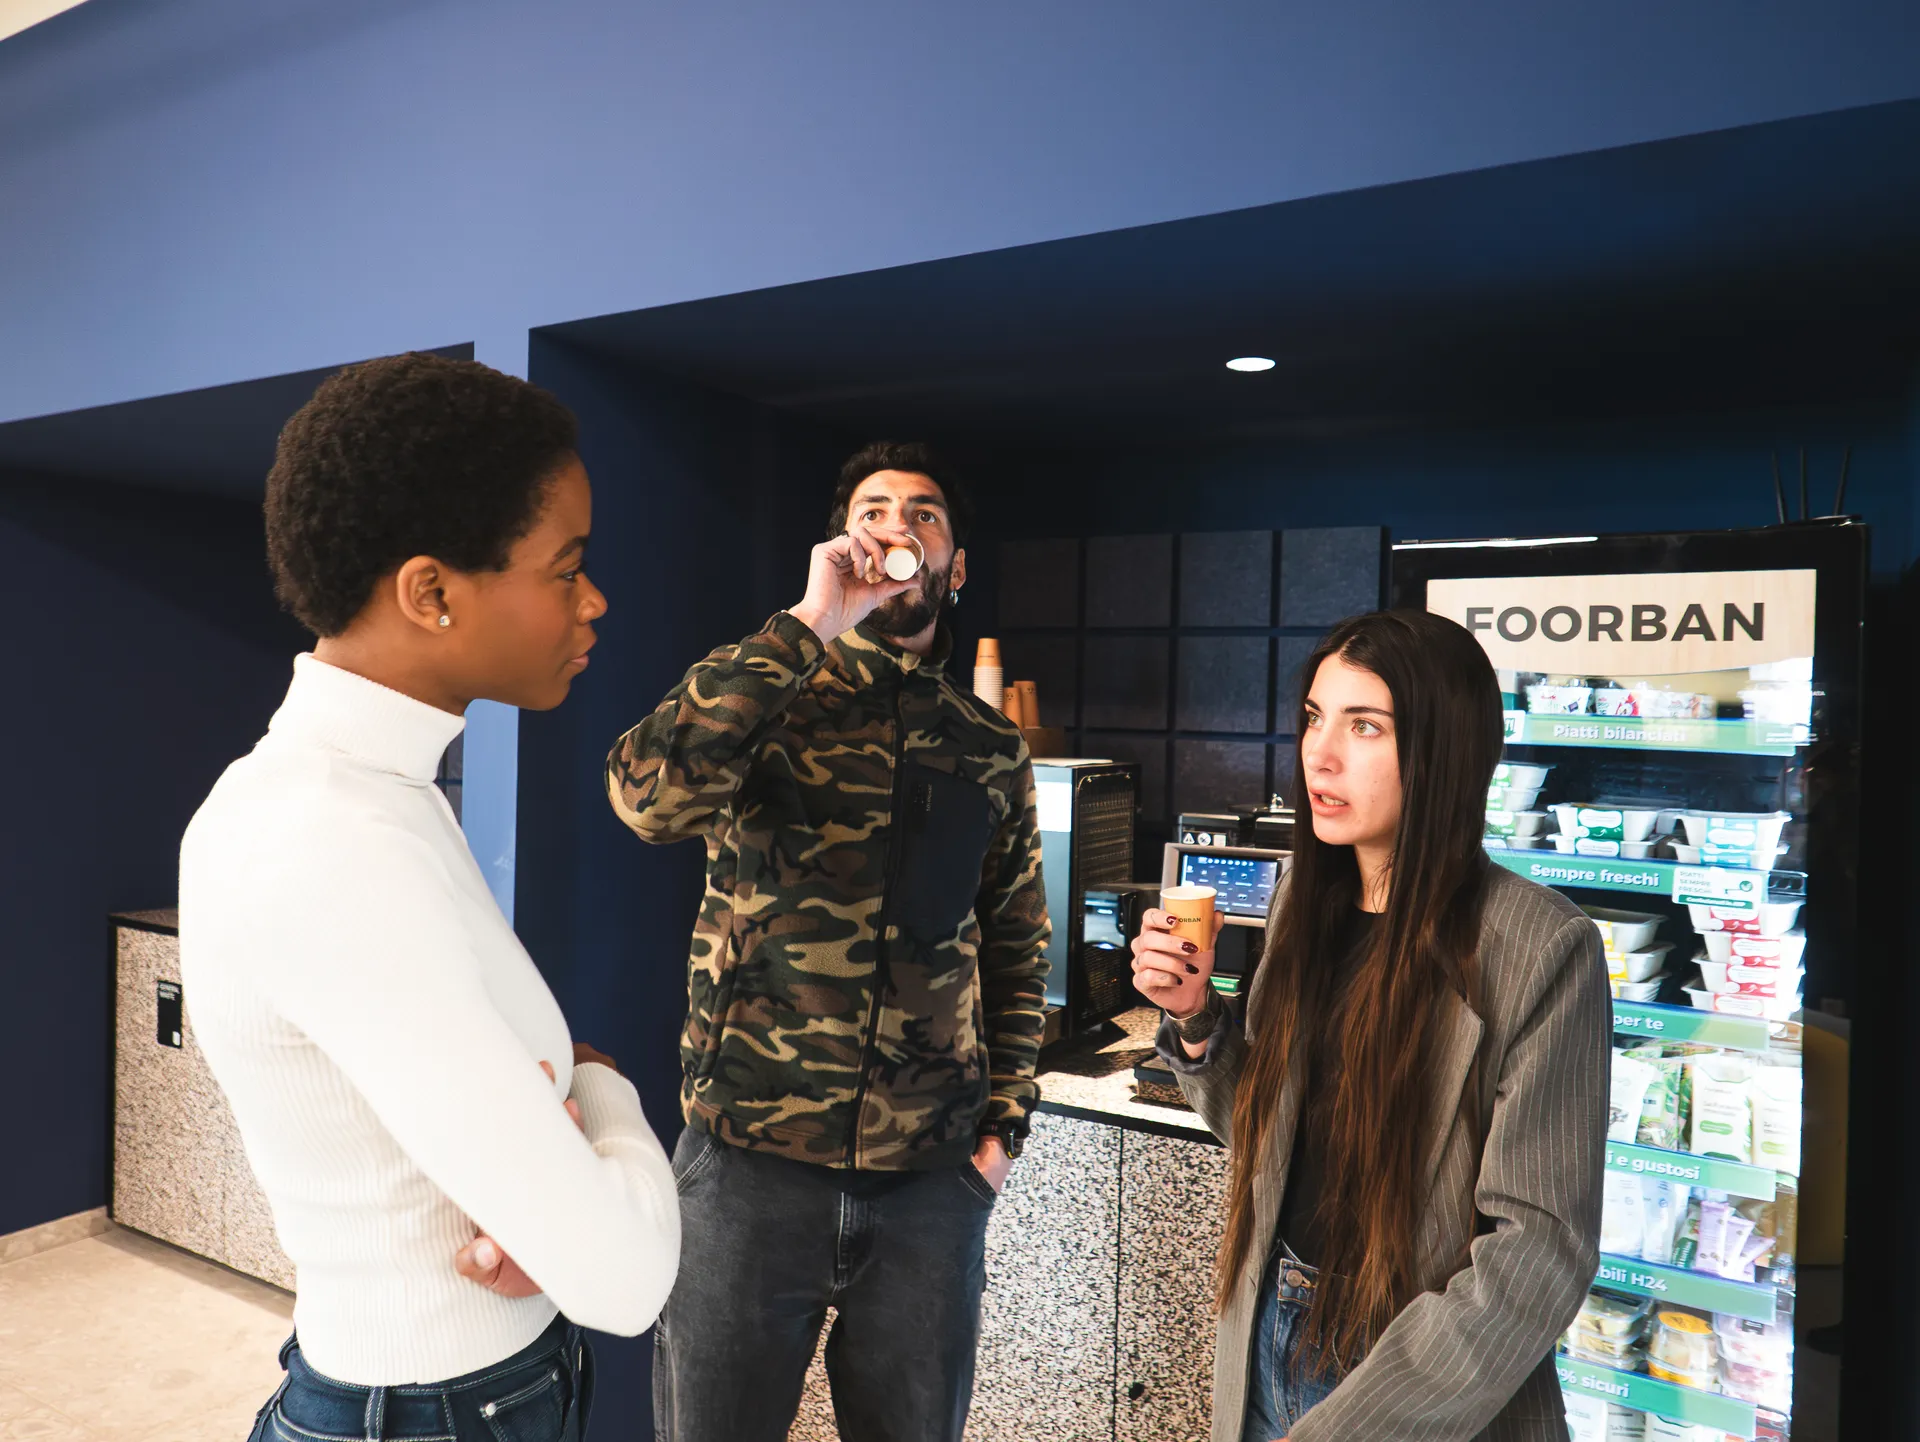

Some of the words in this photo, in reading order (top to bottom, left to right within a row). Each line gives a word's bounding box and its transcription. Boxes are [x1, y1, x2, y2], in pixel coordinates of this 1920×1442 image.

[1466, 603, 1764, 642] FOORBAN
[1553, 725, 1599, 739] Piatti
[1604, 726, 1687, 742] bilanciati
[1530, 864, 1595, 882] Sempre
[1600, 869, 1659, 886] freschi
[1613, 1015, 1641, 1028] per
[1645, 1018, 1664, 1031] te
[1617, 1156, 1629, 1167] e
[1632, 1159, 1700, 1180] gustosi
[1596, 1265, 1627, 1283] bili
[1631, 1272, 1669, 1292] H24
[1582, 1375, 1630, 1398] sicuri
